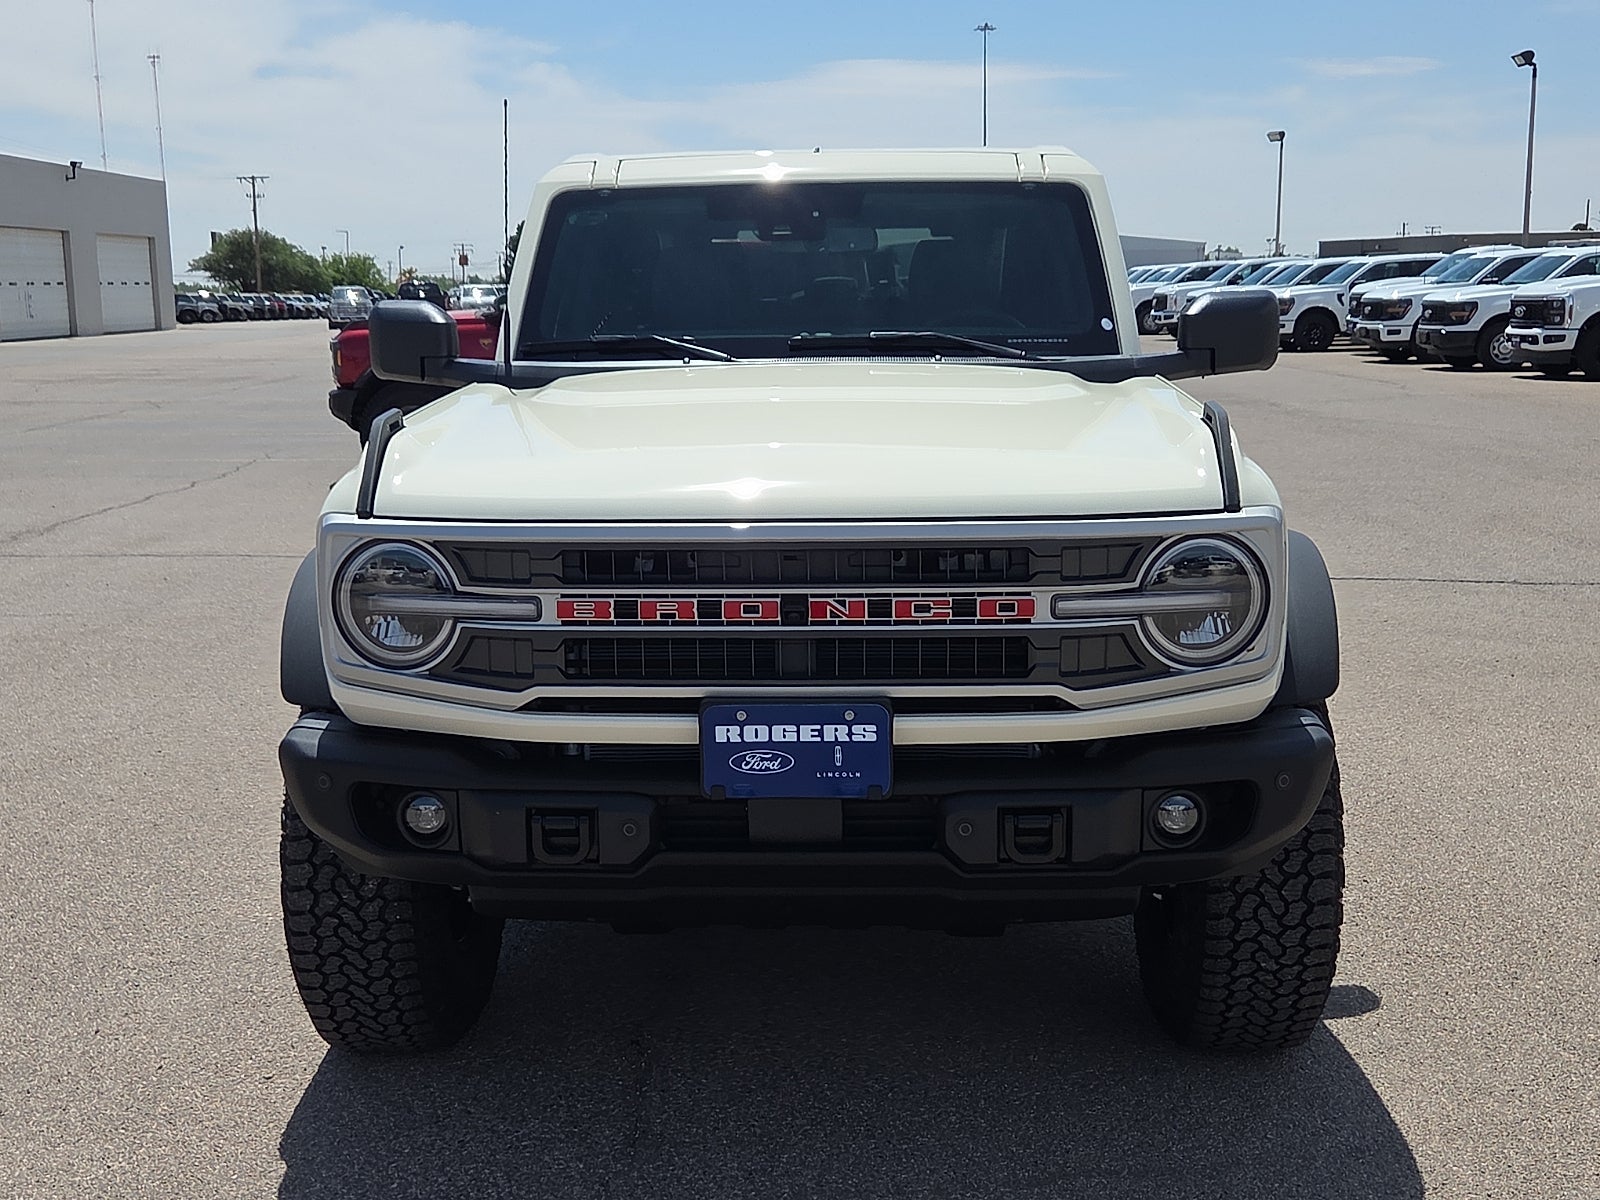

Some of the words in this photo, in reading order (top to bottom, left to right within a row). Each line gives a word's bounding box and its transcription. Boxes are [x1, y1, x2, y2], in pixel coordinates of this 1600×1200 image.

[556, 597, 1036, 621] BRONCO
[714, 725, 877, 743] ROGERS
[741, 753, 781, 770] Ford
